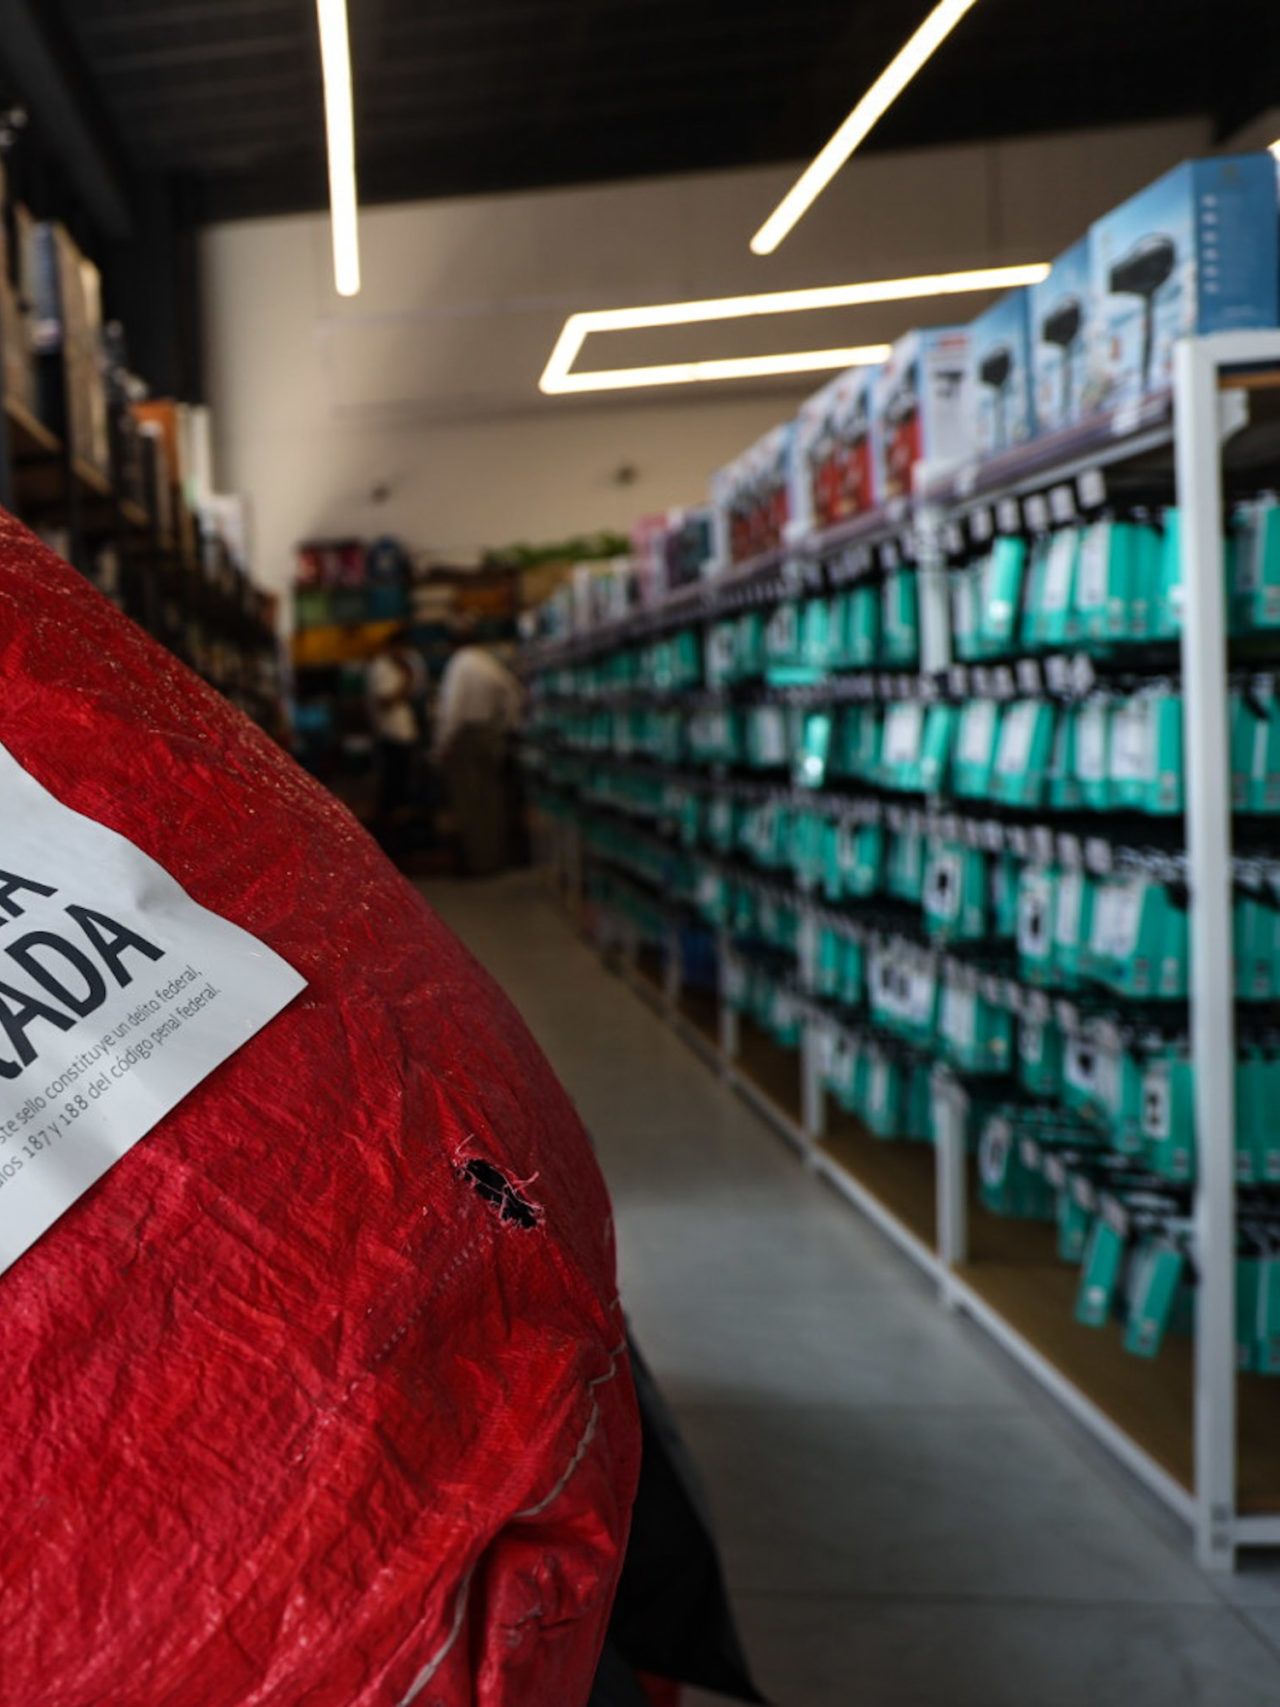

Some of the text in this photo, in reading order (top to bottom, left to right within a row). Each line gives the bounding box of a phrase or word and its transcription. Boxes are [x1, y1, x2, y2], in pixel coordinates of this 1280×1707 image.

[15, 1095, 47, 1126] sello
[44, 1033, 117, 1101] constituye
[112, 1021, 132, 1039] un
[127, 998, 161, 1027] delito
[155, 964, 203, 1001] federal,
[21, 1129, 52, 1160] 187
[47, 1122, 64, 1140] y
[58, 1094, 90, 1128] 188
[86, 1071, 113, 1101] del
[150, 1012, 183, 1047] penal
[175, 982, 223, 1021] federal.
